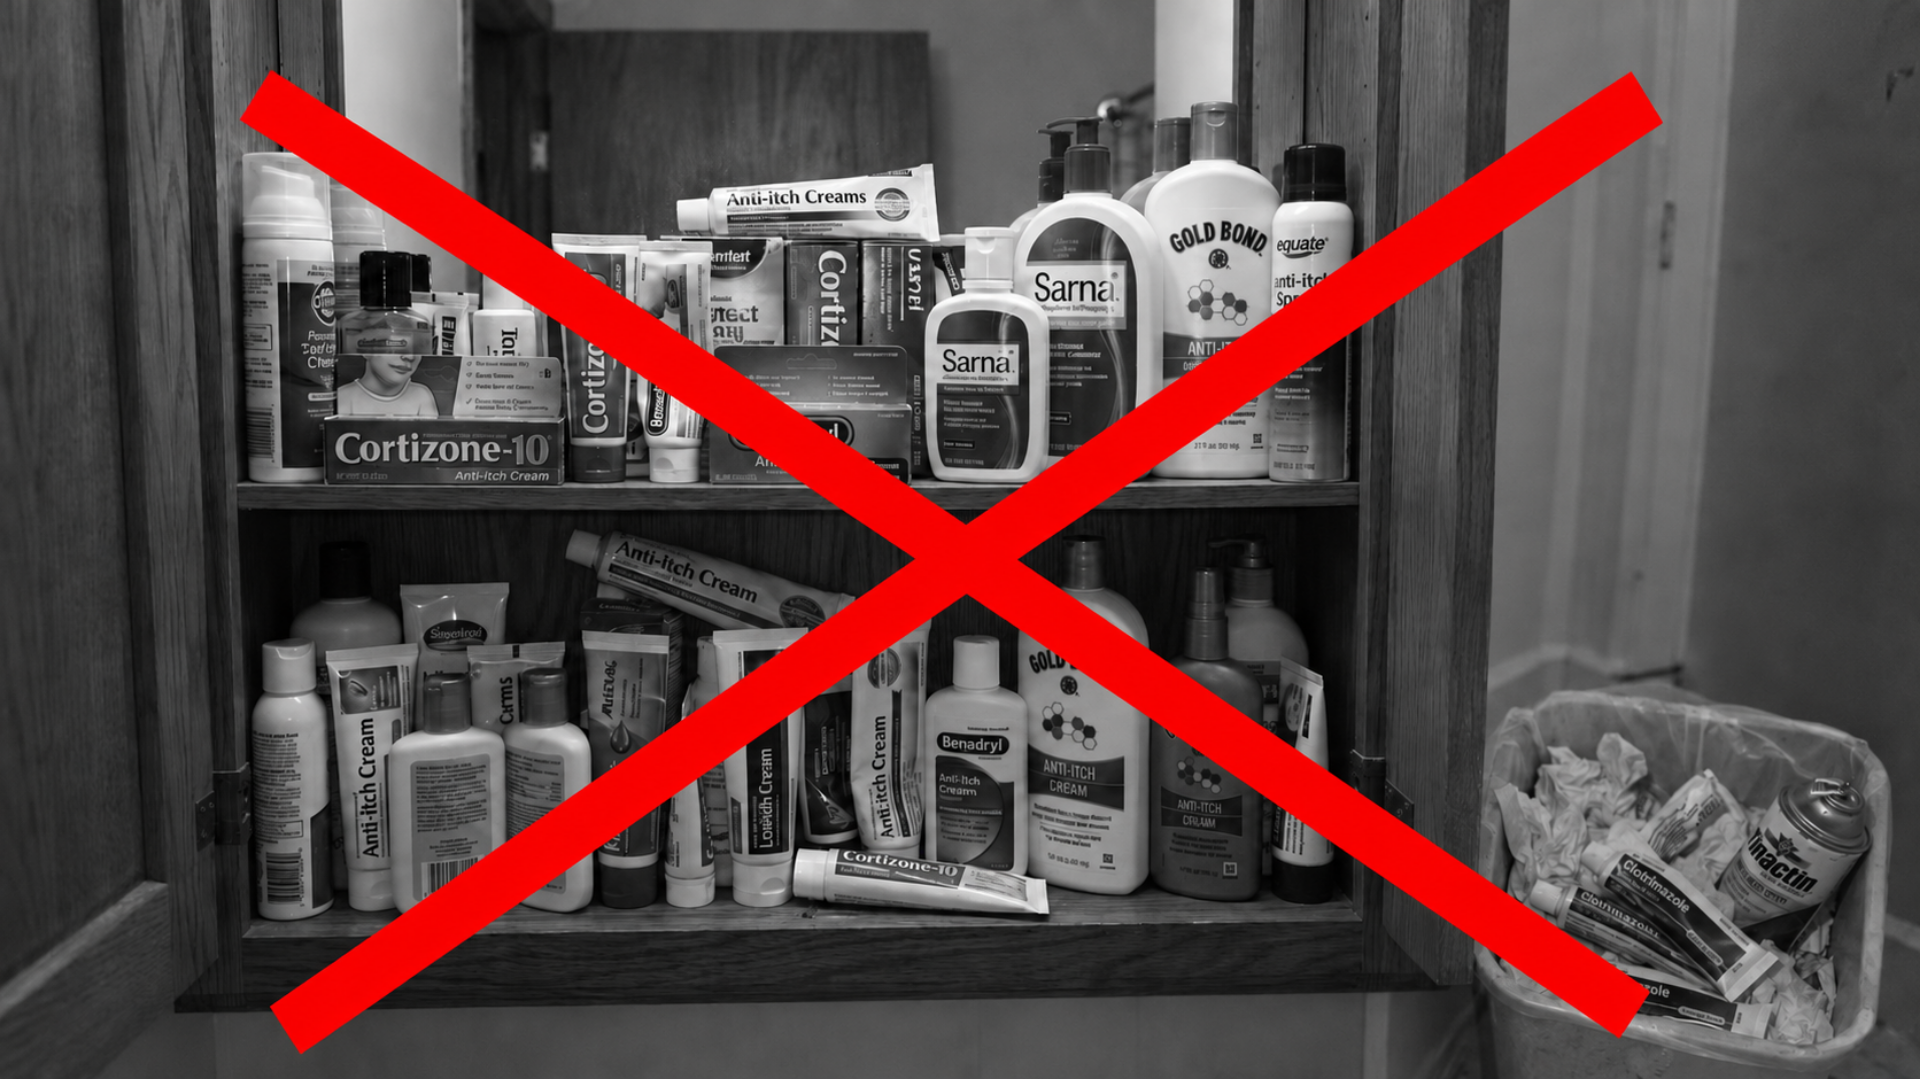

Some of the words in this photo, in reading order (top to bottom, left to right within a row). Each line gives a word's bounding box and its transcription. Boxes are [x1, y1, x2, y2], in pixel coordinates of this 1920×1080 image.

[726, 189, 800, 207] Anti-itch
[804, 188, 867, 204] Creams
[1169, 221, 1216, 254] GOLD
[1276, 236, 1326, 253] equate
[818, 249, 848, 346] Cortiz
[335, 432, 550, 465] Cortizone-10
[510, 471, 549, 481] Cream
[614, 540, 696, 581] Anti-itch
[698, 568, 759, 604] Cream
[358, 717, 377, 779] Cream
[871, 715, 886, 771] Cream
[942, 735, 1003, 754] Benadryl
[1043, 758, 1096, 781] ANTI-ITCH
[1049, 779, 1088, 798] CREAM
[358, 782, 380, 858] Anti-itch
[1177, 799, 1222, 815] ANTI-ITCH
[842, 850, 959, 877] Cortizone-10
[1623, 859, 1690, 913] Clotrimazole
